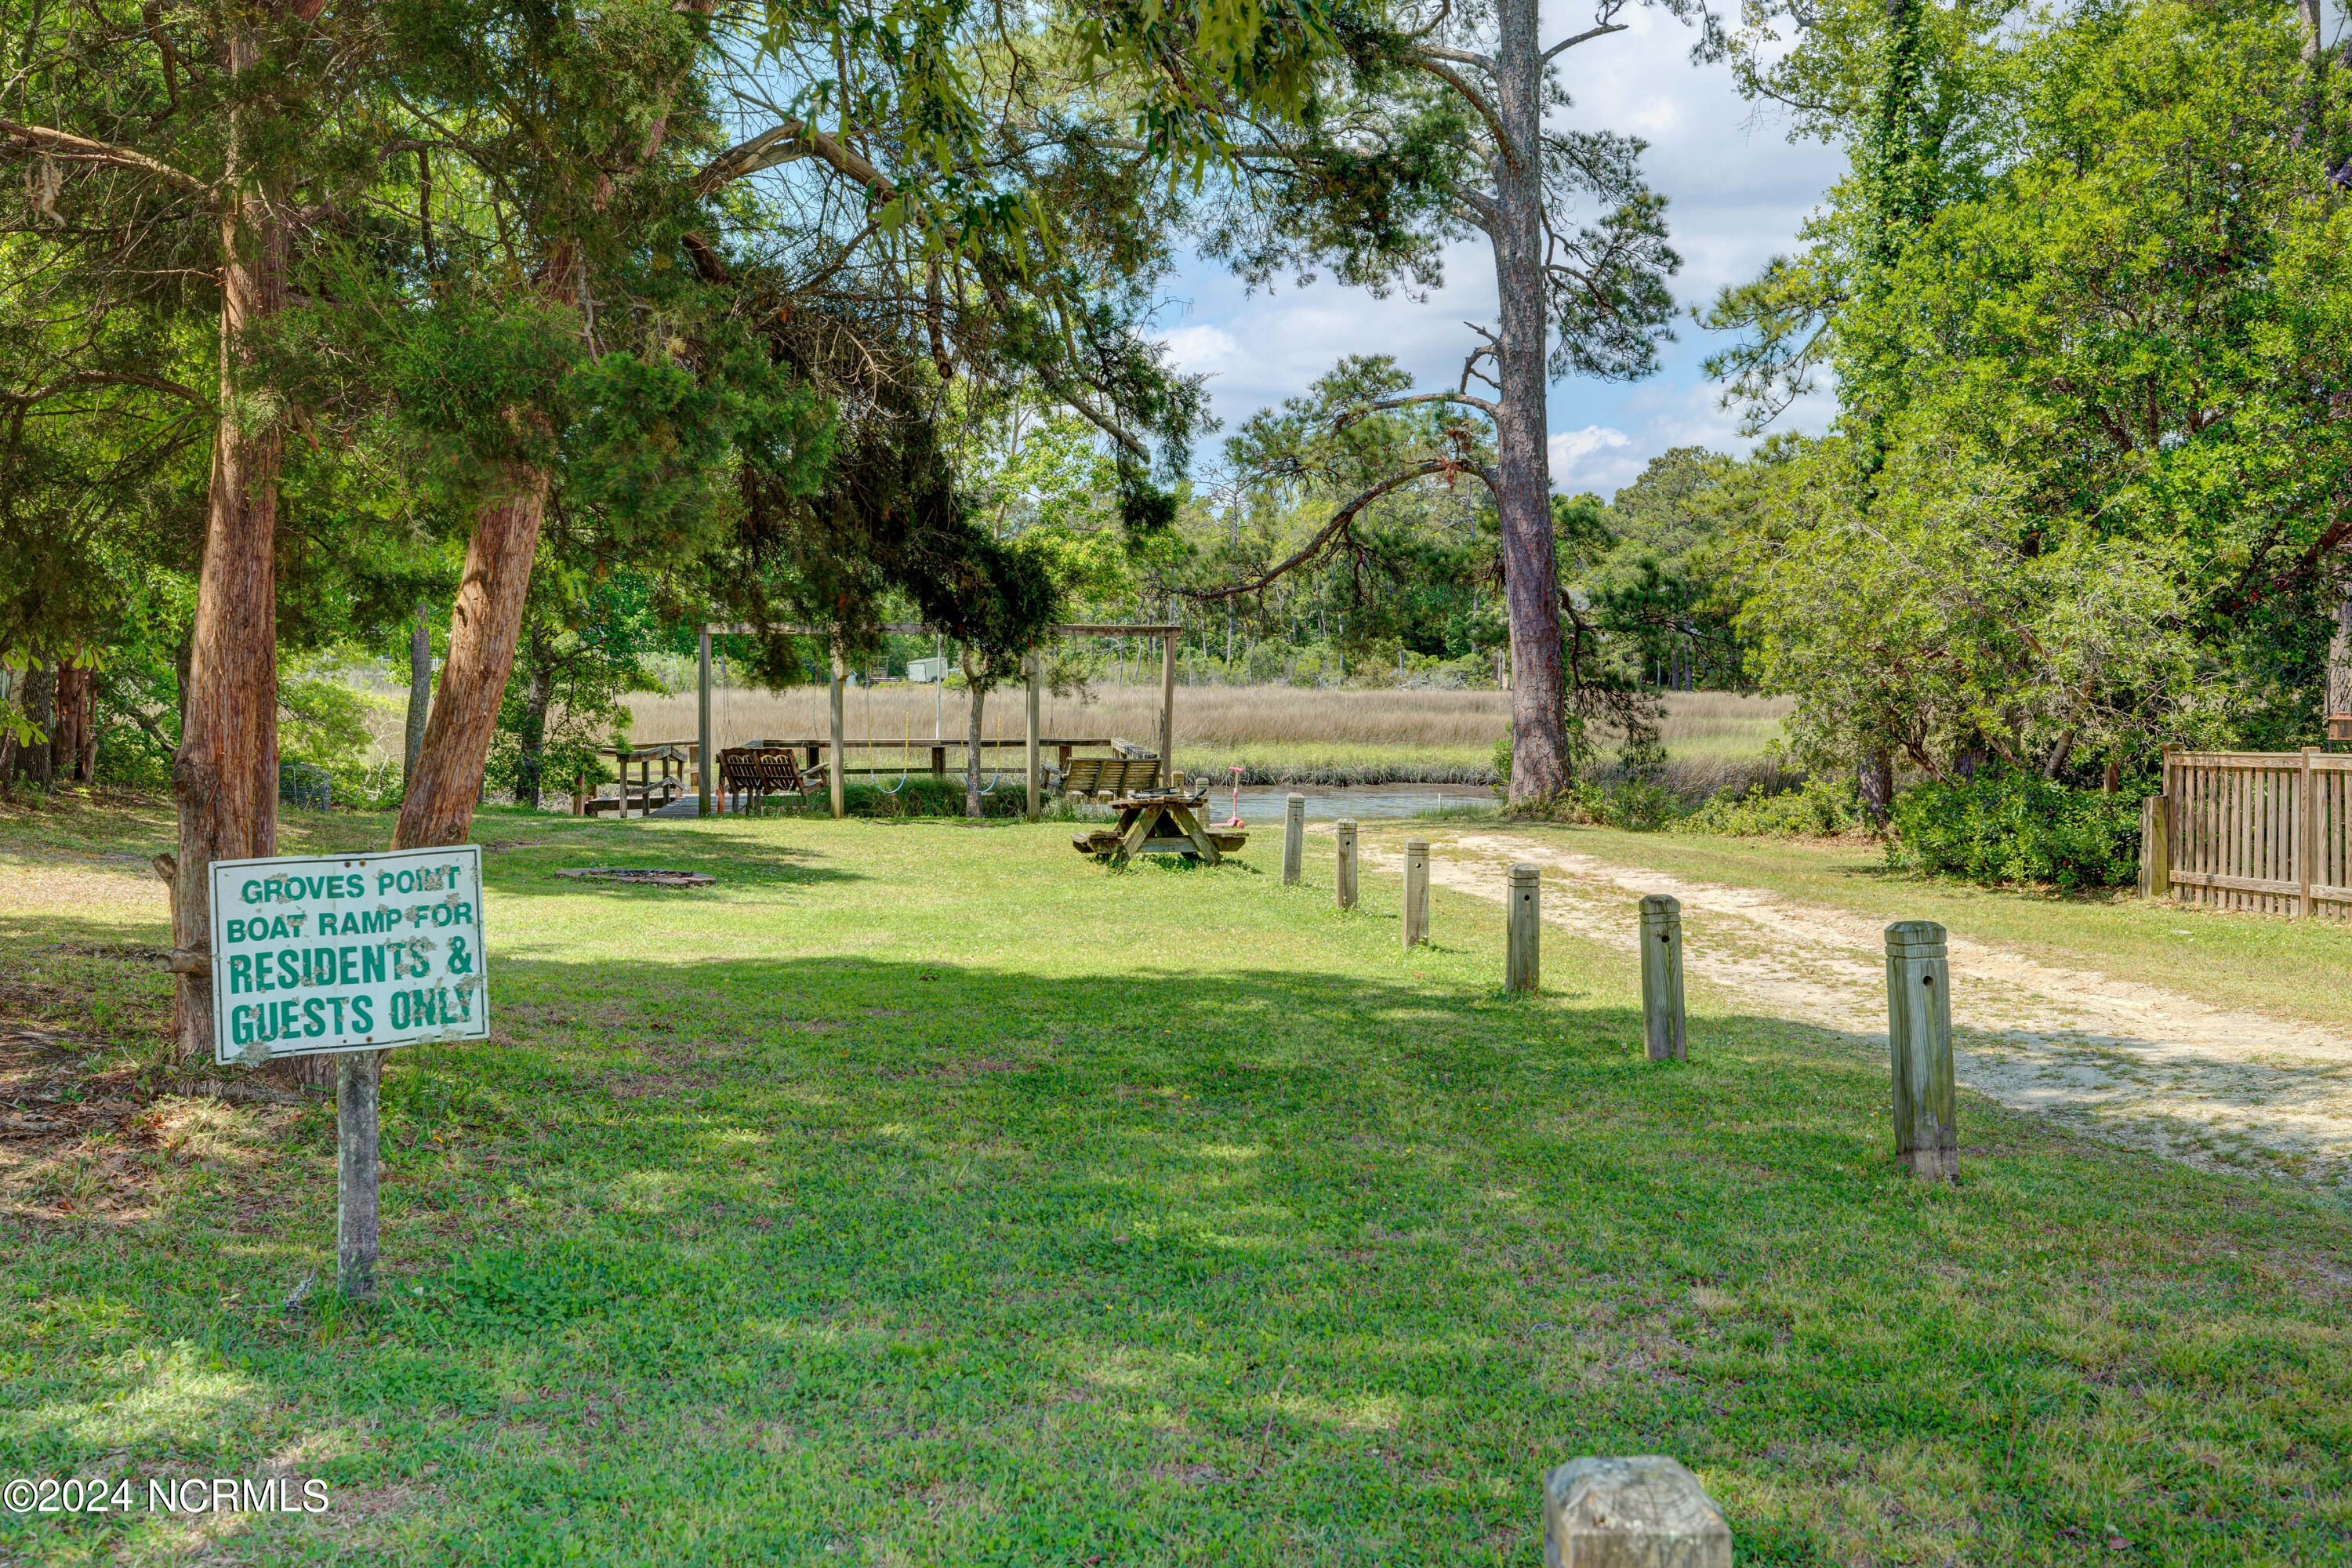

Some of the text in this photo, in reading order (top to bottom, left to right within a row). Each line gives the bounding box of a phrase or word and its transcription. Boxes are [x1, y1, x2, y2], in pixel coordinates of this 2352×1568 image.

[241, 874, 365, 904] GROVES
[227, 902, 472, 943] BOAT RAMP FOR
[230, 935, 474, 994] RESIDENTS &
[231, 995, 374, 1046] GUESTS
